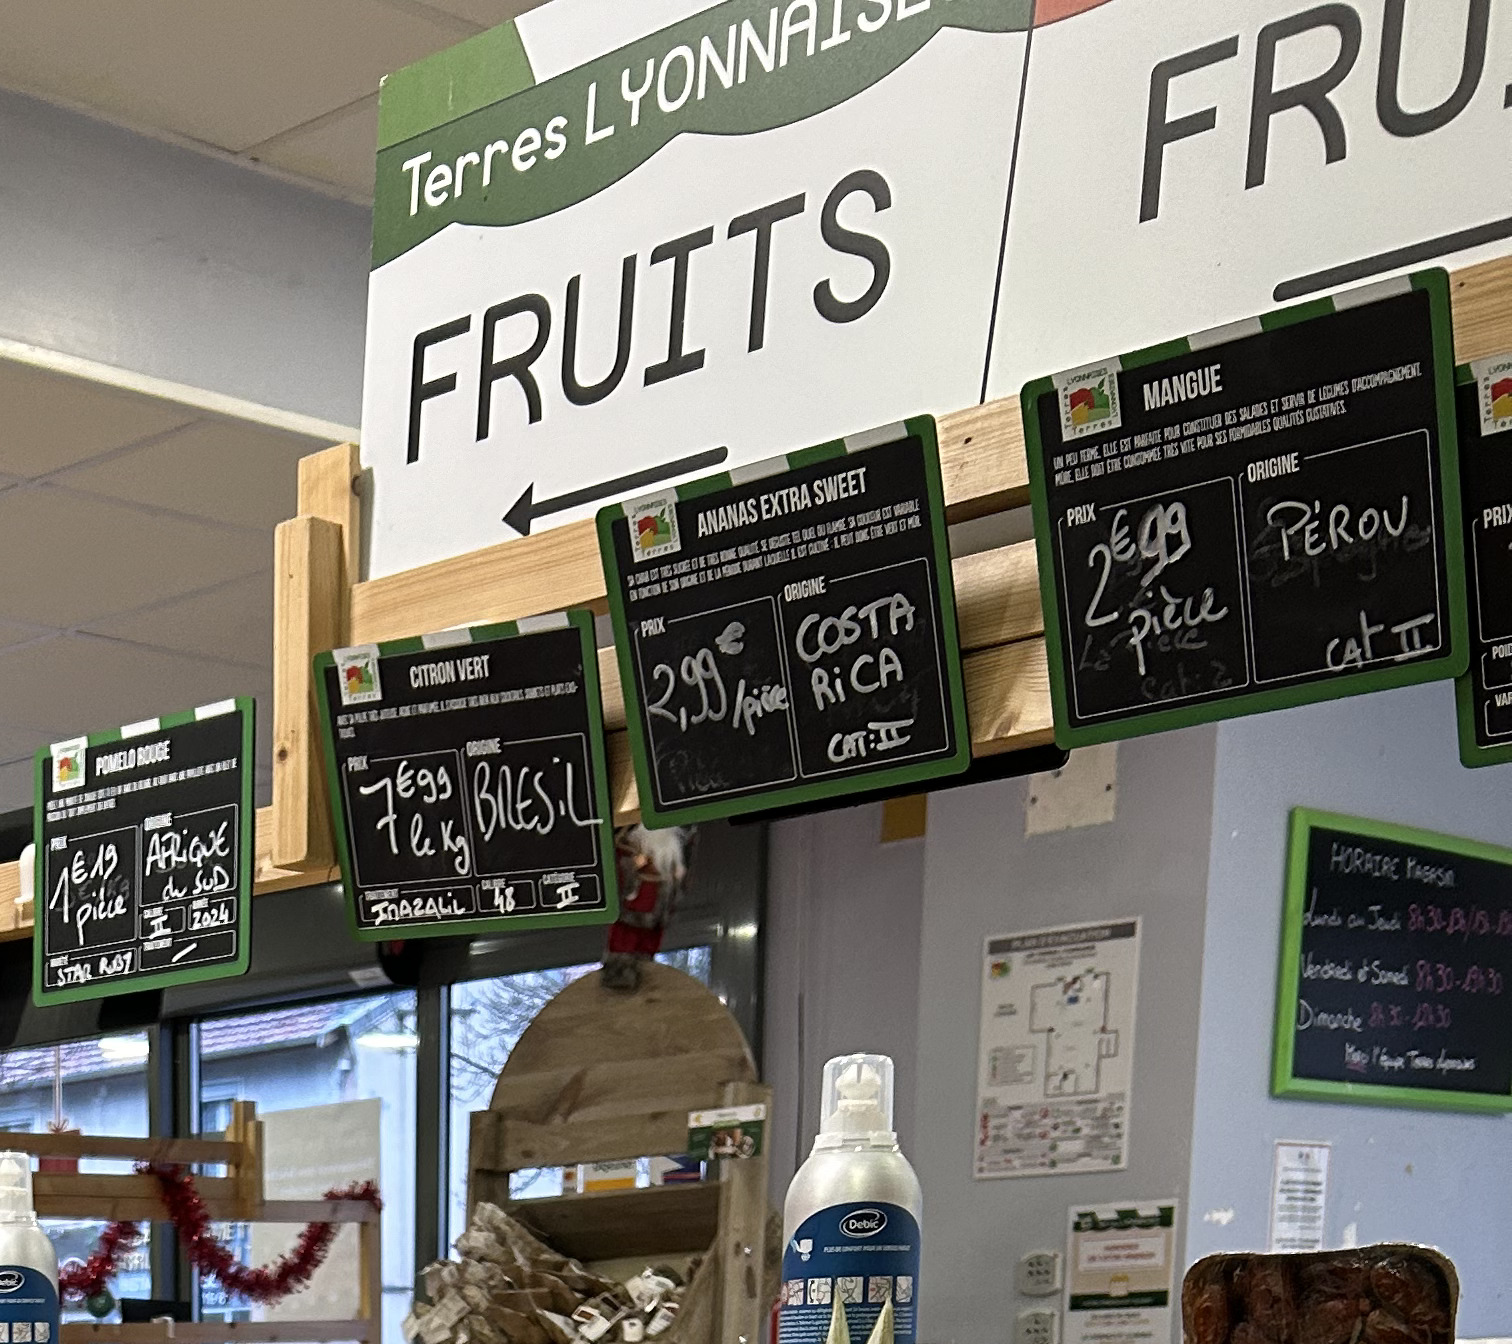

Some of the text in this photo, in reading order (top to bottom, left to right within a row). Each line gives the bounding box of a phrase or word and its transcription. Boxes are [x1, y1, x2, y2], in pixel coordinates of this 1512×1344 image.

[402, 0, 960, 217] Terres LYONNAIS
[1138, 0, 1512, 223] FRU
[407, 168, 893, 466] FRUITS
[1143, 364, 1223, 412] MANGUE
[1270, 398, 1279, 414] ET
[1247, 453, 1300, 483] ORIGINE
[697, 467, 867, 538] ANANAS EXTRA SWEET
[1066, 507, 1097, 528] PRIX
[1267, 495, 1409, 561] PÉROU
[785, 576, 827, 602] ORIGINE
[641, 617, 665, 637] PRIX
[796, 593, 915, 664] COSTA
[1129, 585, 1228, 675] pièce
[1391, 614, 1434, 662] II
[1492, 645, 1512, 659] POID
[410, 655, 490, 688] CITRON VERT
[96, 740, 171, 776] POMELO ROUGE
[410, 813, 436, 857] le
[192, 903, 229, 929] 2024
[1297, 998, 1363, 1032] Dimanche
[849, 1218, 879, 1230] Debic
